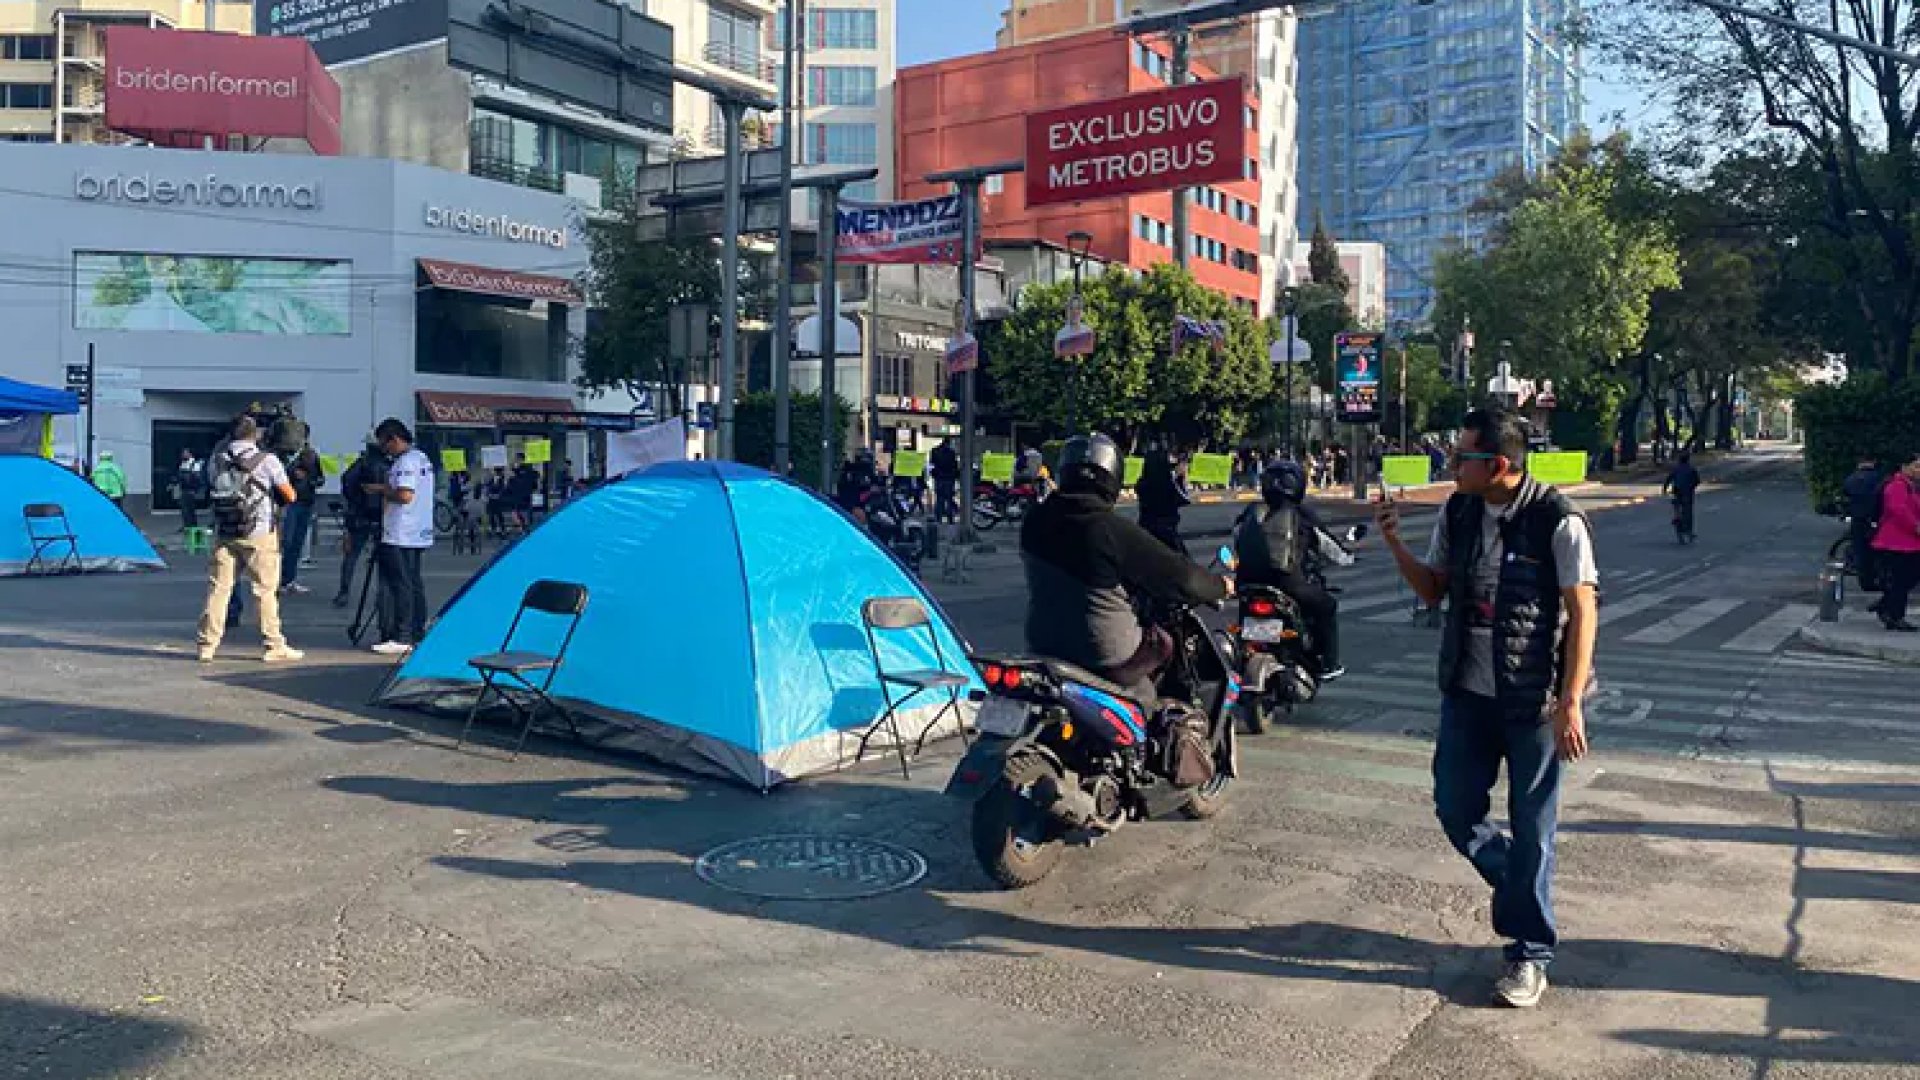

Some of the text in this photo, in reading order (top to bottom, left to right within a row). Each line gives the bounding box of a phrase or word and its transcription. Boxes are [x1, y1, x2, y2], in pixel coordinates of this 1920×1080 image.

[116, 65, 298, 98] bridenformal
[1049, 97, 1219, 150] EXCLUSIVO
[1049, 140, 1215, 188] METROBUS
[74, 168, 324, 210] bridenformal
[425, 200, 567, 248] bridenformal
[834, 195, 962, 236] MENDOZ
[428, 400, 495, 422] bride
